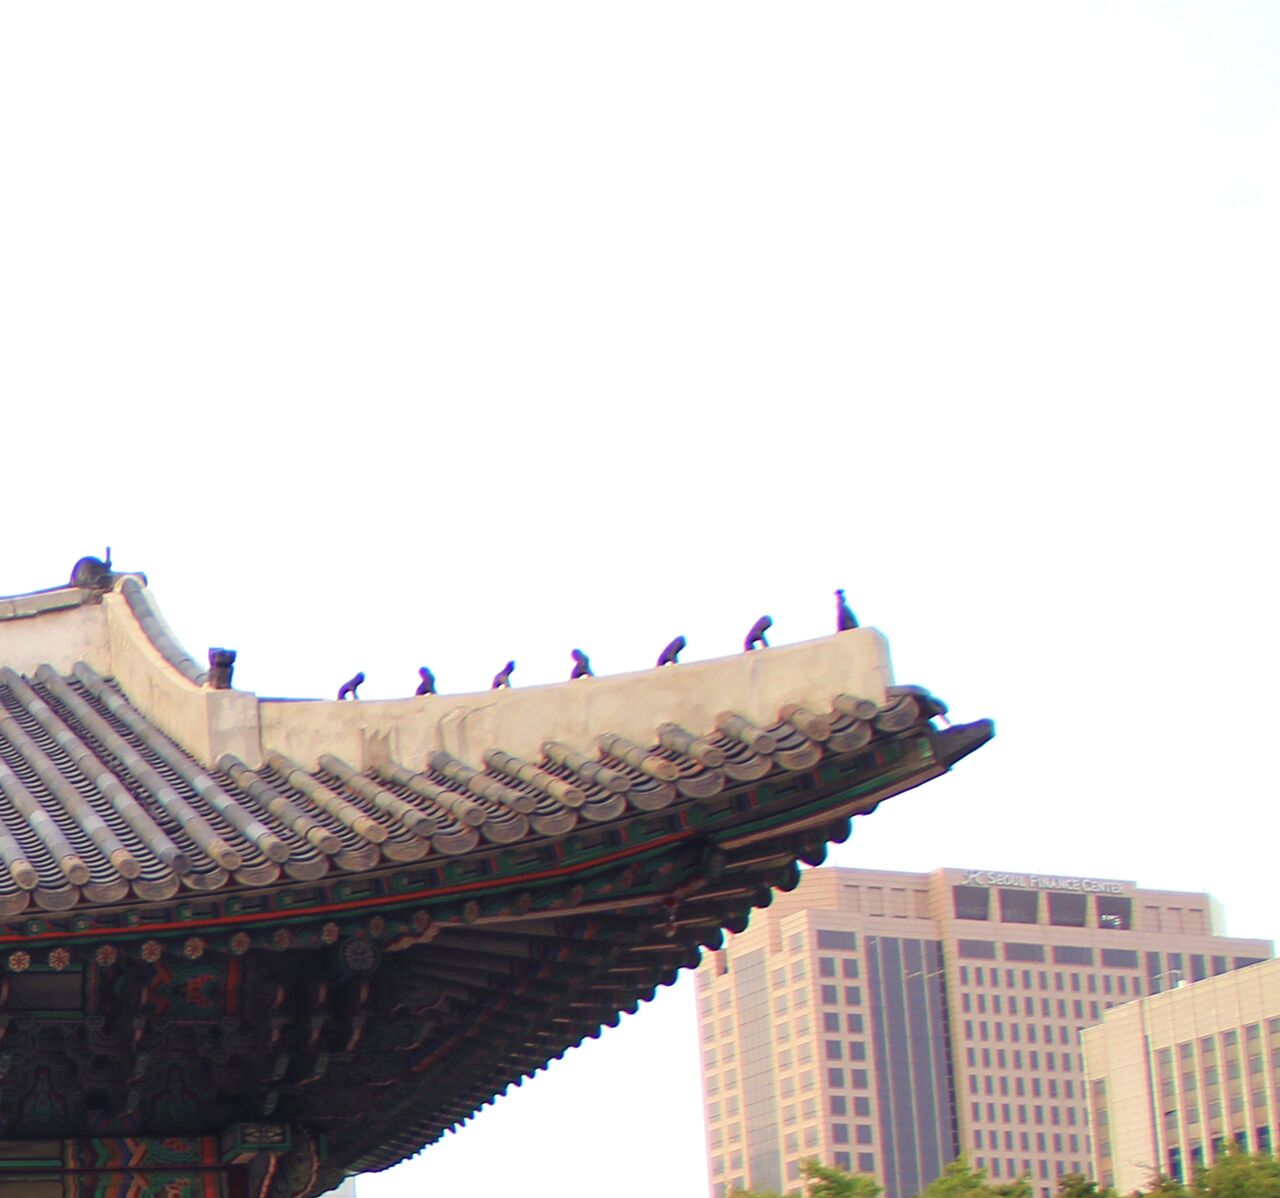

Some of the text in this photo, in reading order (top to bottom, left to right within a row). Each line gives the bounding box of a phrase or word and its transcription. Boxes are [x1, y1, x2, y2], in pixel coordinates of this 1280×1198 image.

[987, 872, 1026, 888] SEOUL
[1030, 875, 1080, 890] FINANCE
[1082, 880, 1124, 894] CENTER
